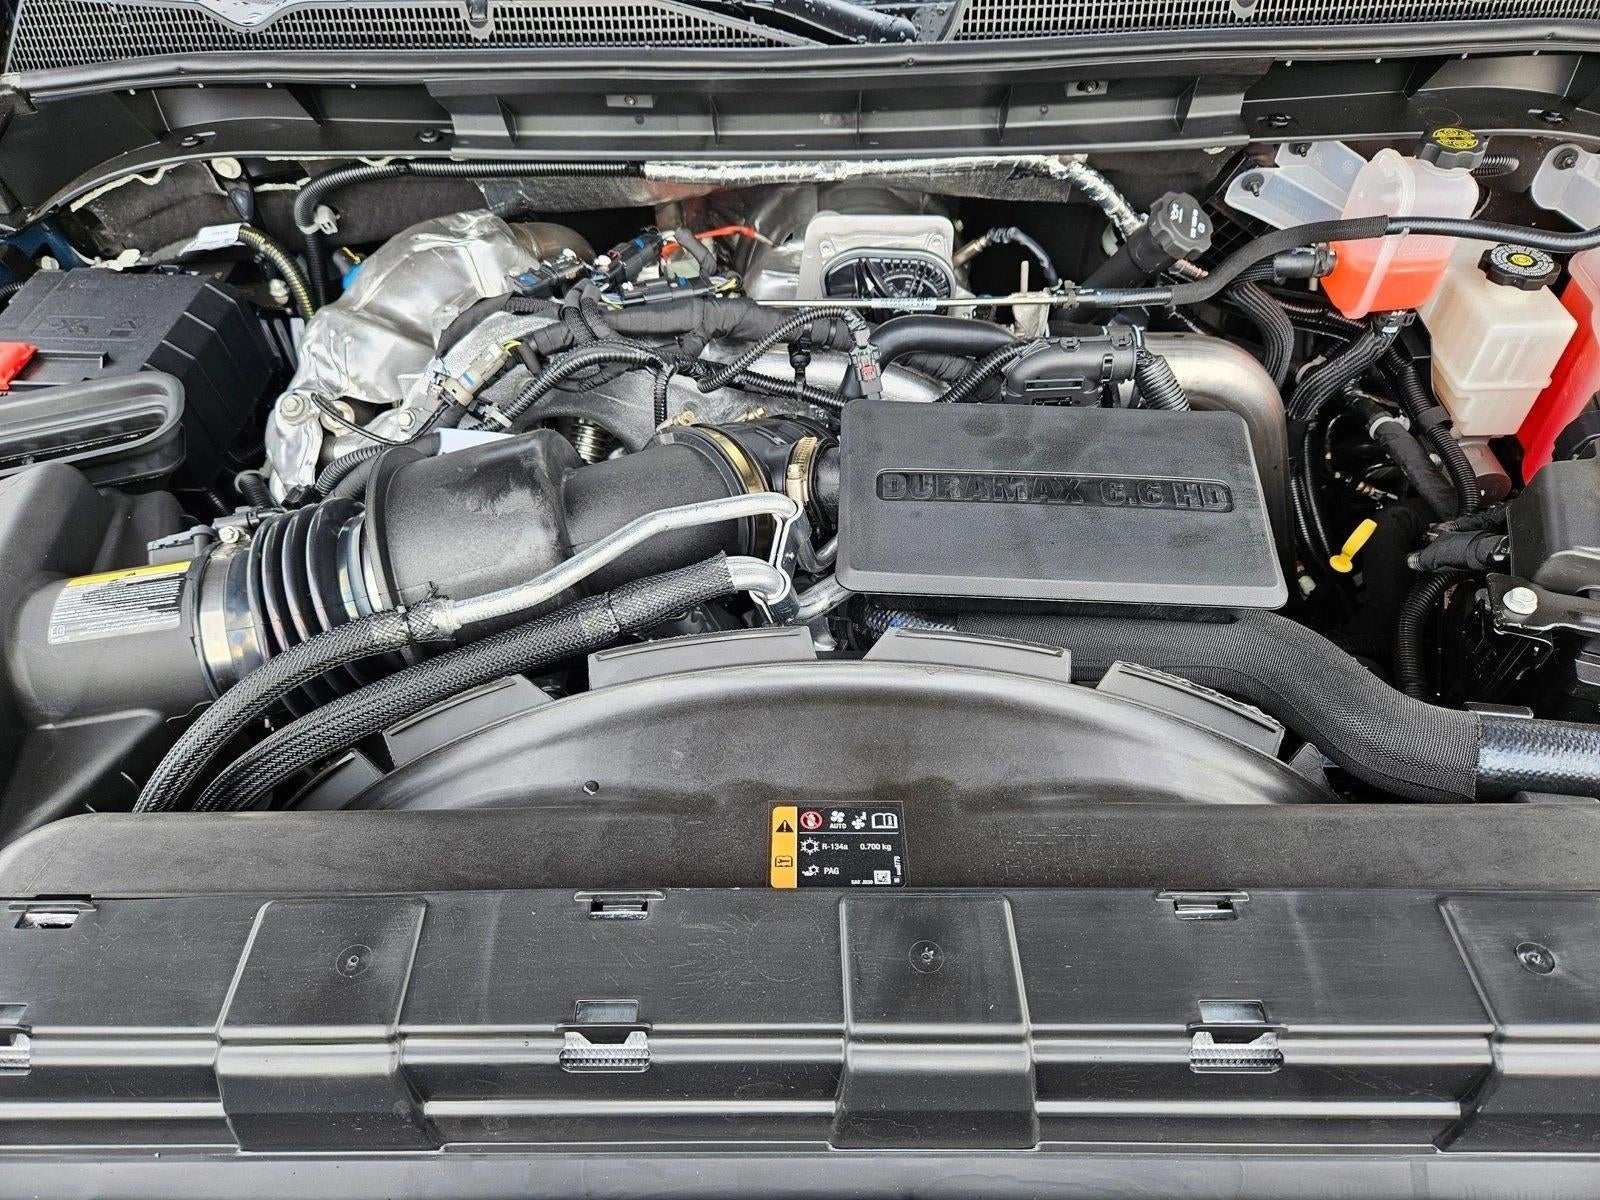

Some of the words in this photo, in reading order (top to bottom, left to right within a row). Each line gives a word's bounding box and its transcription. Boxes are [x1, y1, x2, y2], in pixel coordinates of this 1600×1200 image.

[882, 474, 1083, 503] DURAMAX
[1100, 480, 1164, 506] 6.6
[1172, 481, 1228, 511] HD
[882, 843, 892, 851] kg
[823, 867, 840, 875] PAG
